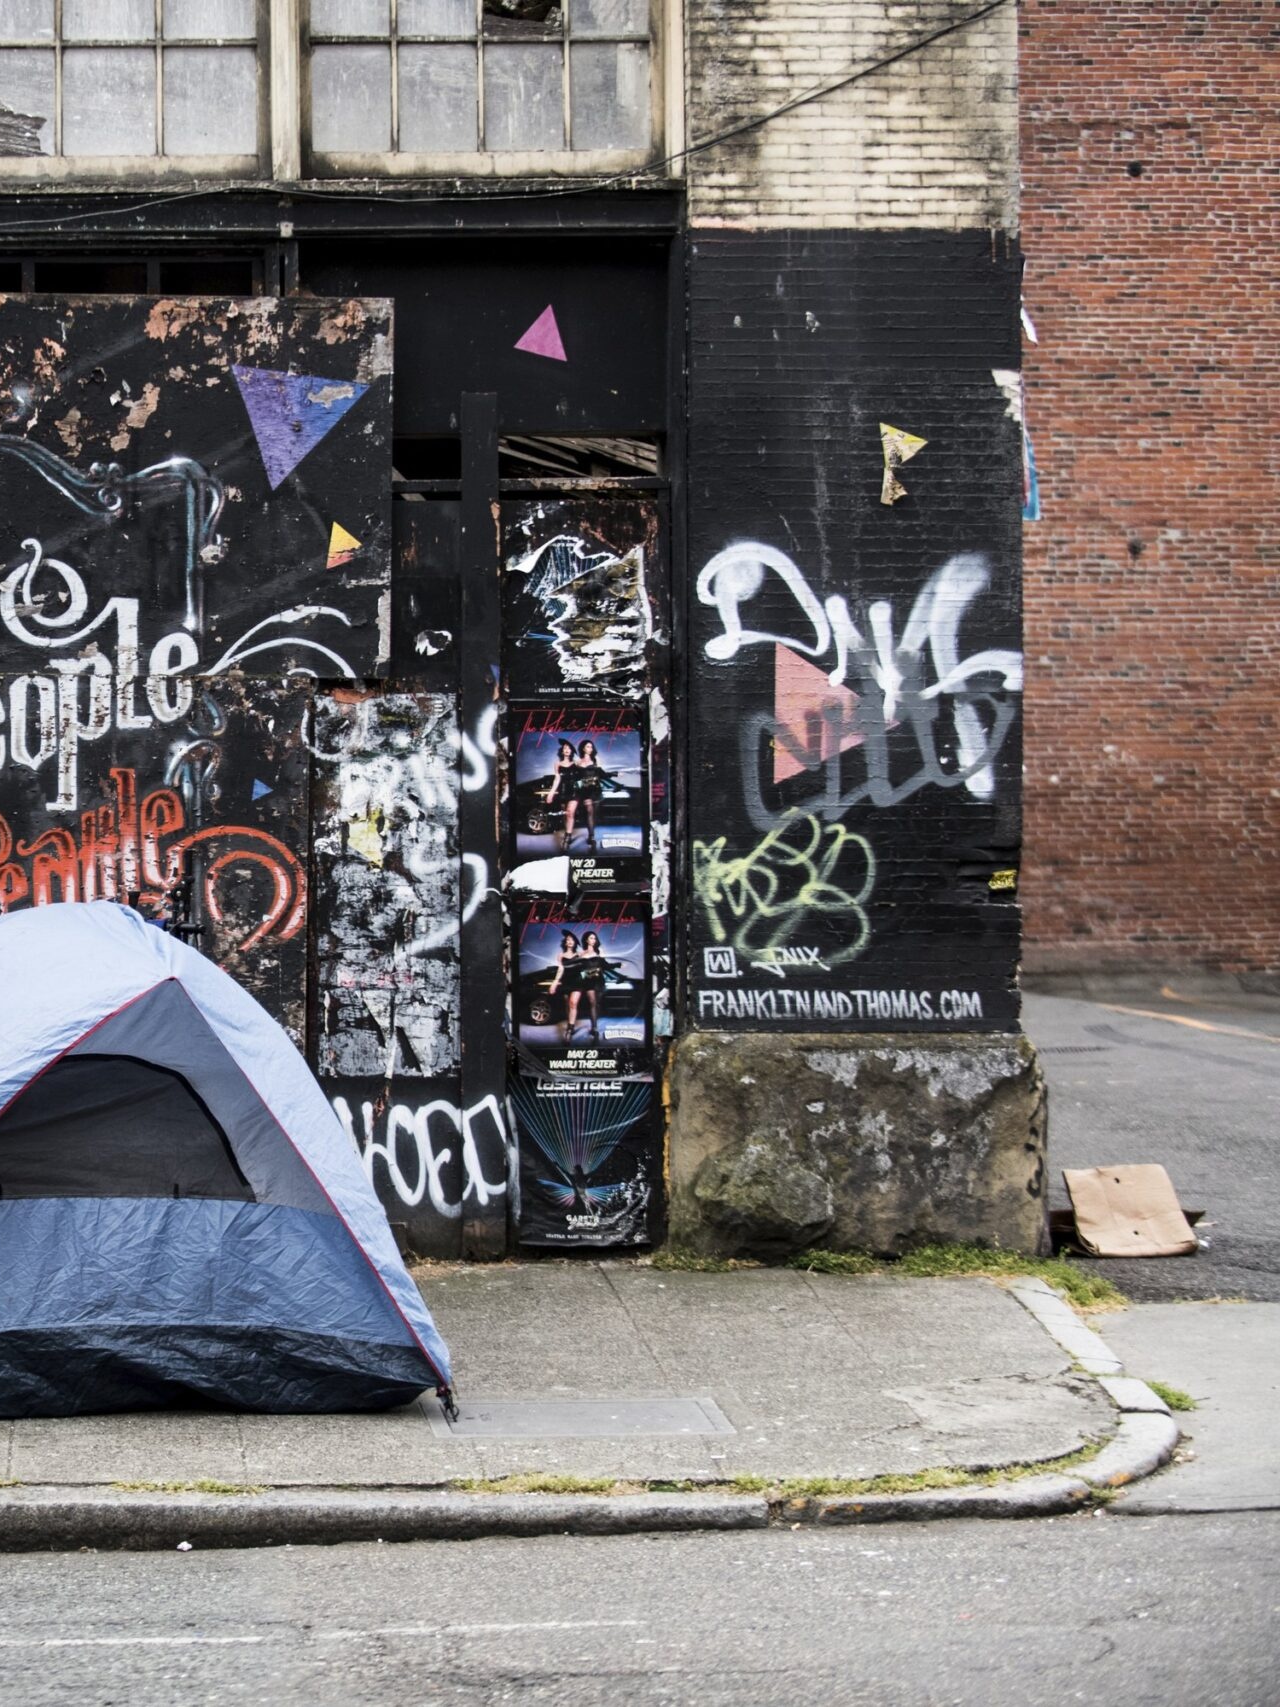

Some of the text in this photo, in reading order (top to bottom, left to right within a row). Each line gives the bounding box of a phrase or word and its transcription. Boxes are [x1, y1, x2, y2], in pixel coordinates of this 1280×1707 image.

[583, 859, 596, 867] 20
[575, 868, 614, 877] THEATER
[697, 988, 984, 1019] FRANKLINANDTHOMAS.COM
[567, 1050, 598, 1059] MAY 20
[549, 1060, 617, 1069] WAMU THEATER
